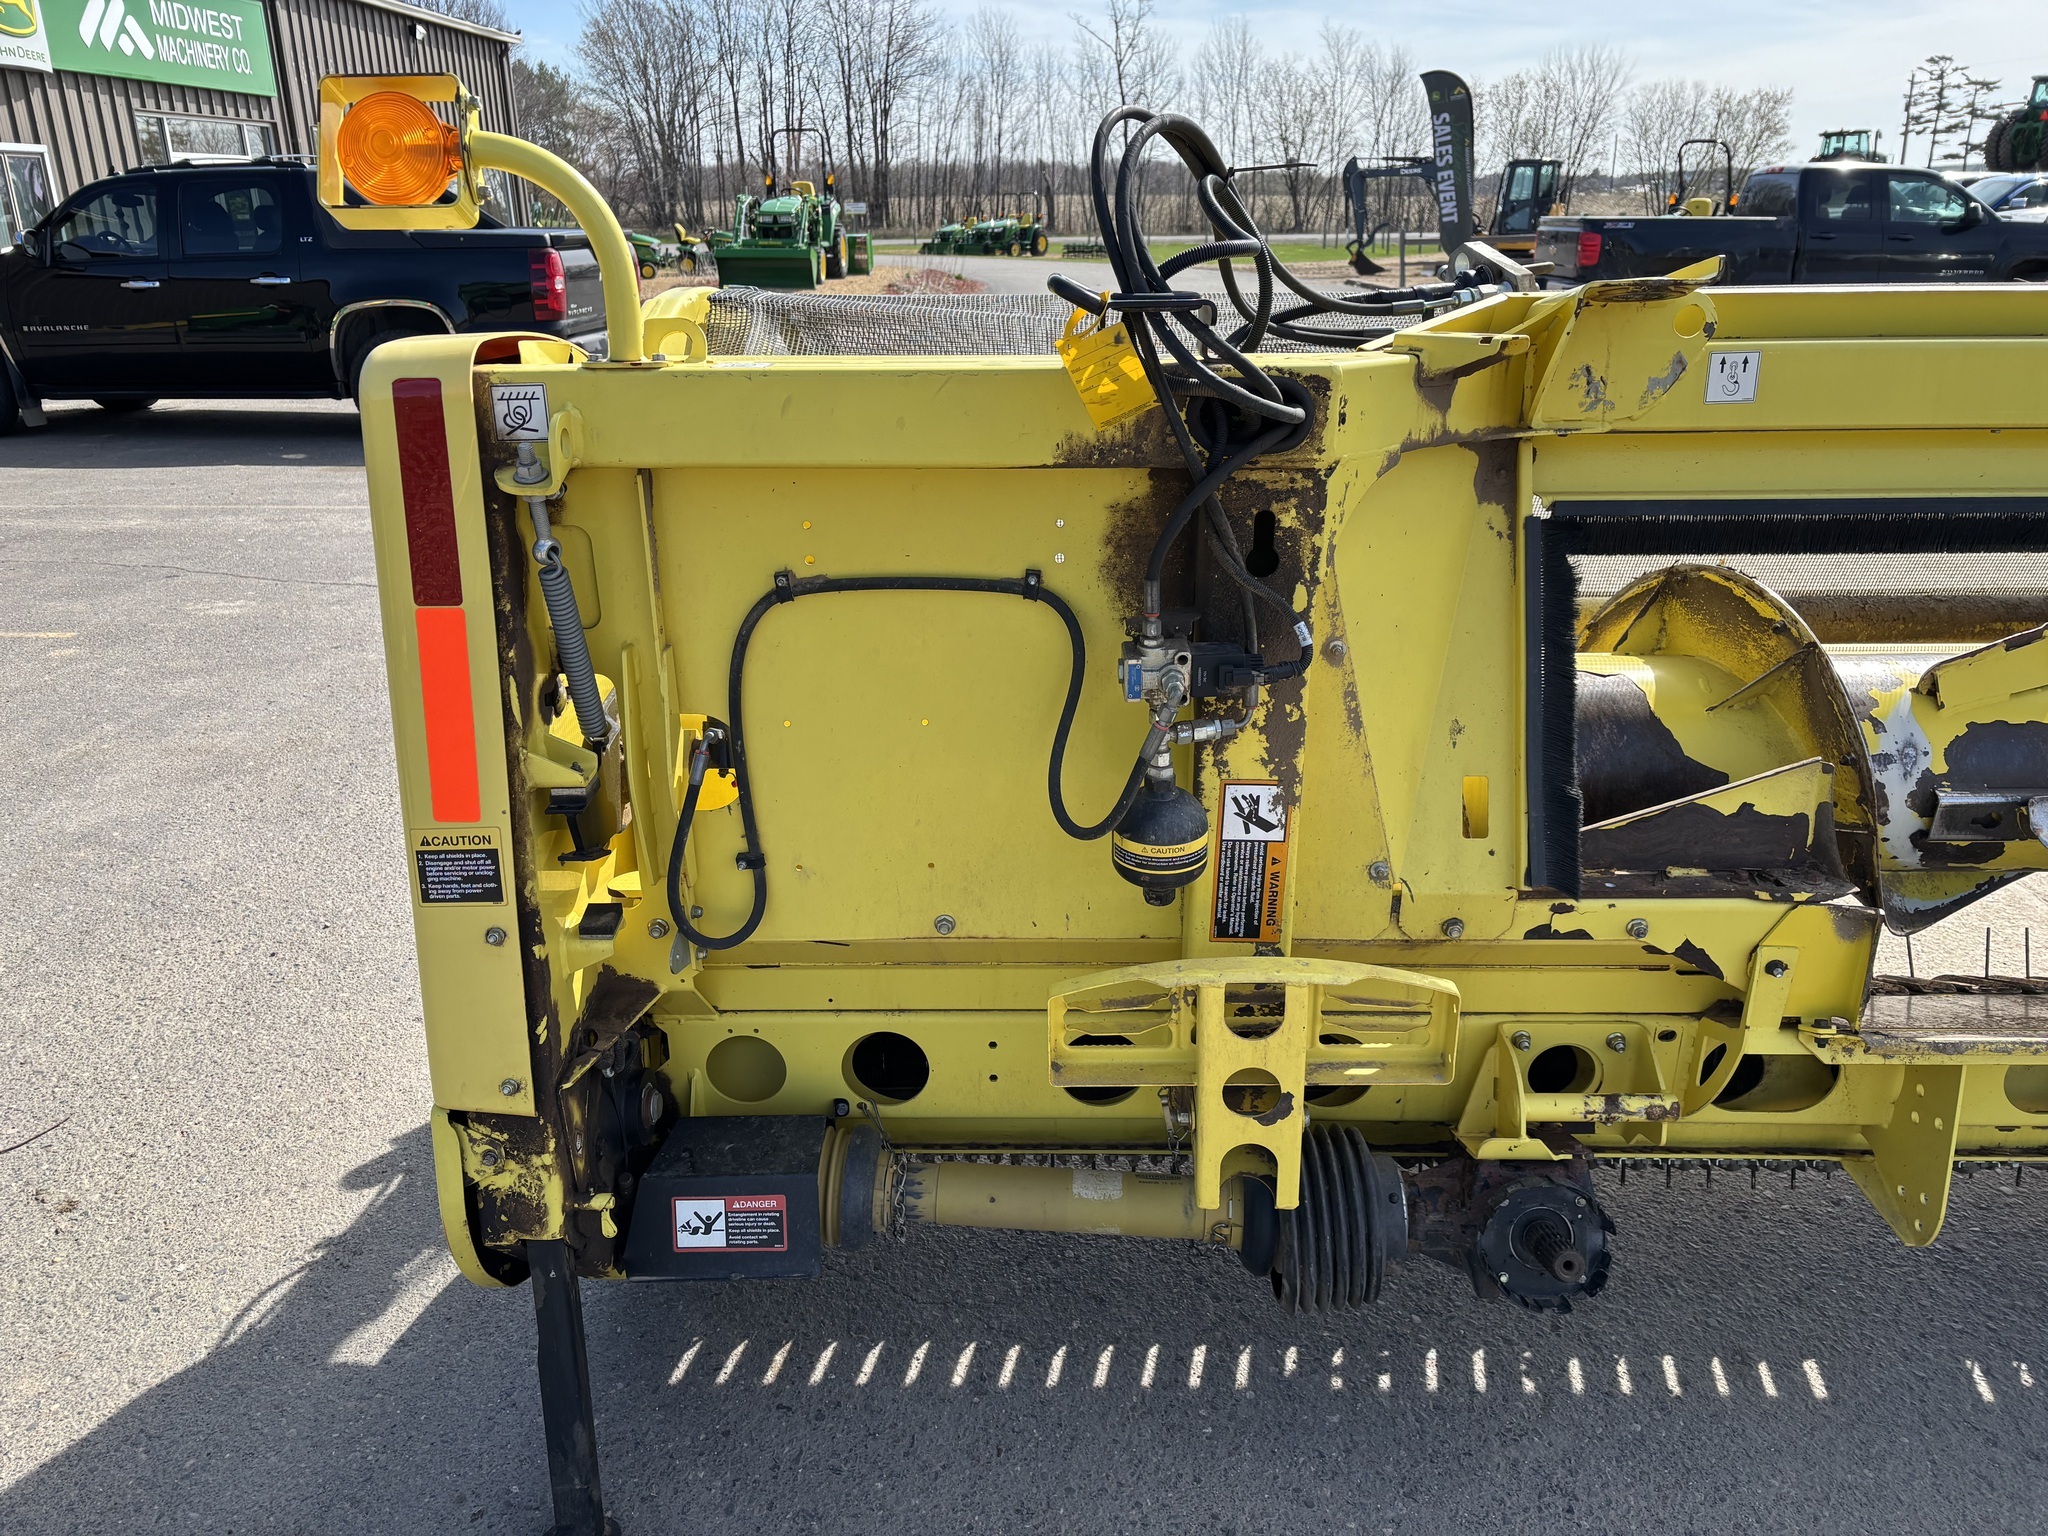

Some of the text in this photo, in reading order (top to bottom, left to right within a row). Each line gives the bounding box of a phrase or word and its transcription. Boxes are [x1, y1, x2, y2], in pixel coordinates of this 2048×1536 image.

[149, 0, 243, 41] MIDWEST
[0, 46, 46, 63] HN DEERE
[156, 34, 252, 75] MACHINERY CO.
[1433, 113, 1458, 223] SALES EVENT
[432, 835, 491, 846] CAUTION
[1266, 871, 1280, 926] WARNING
